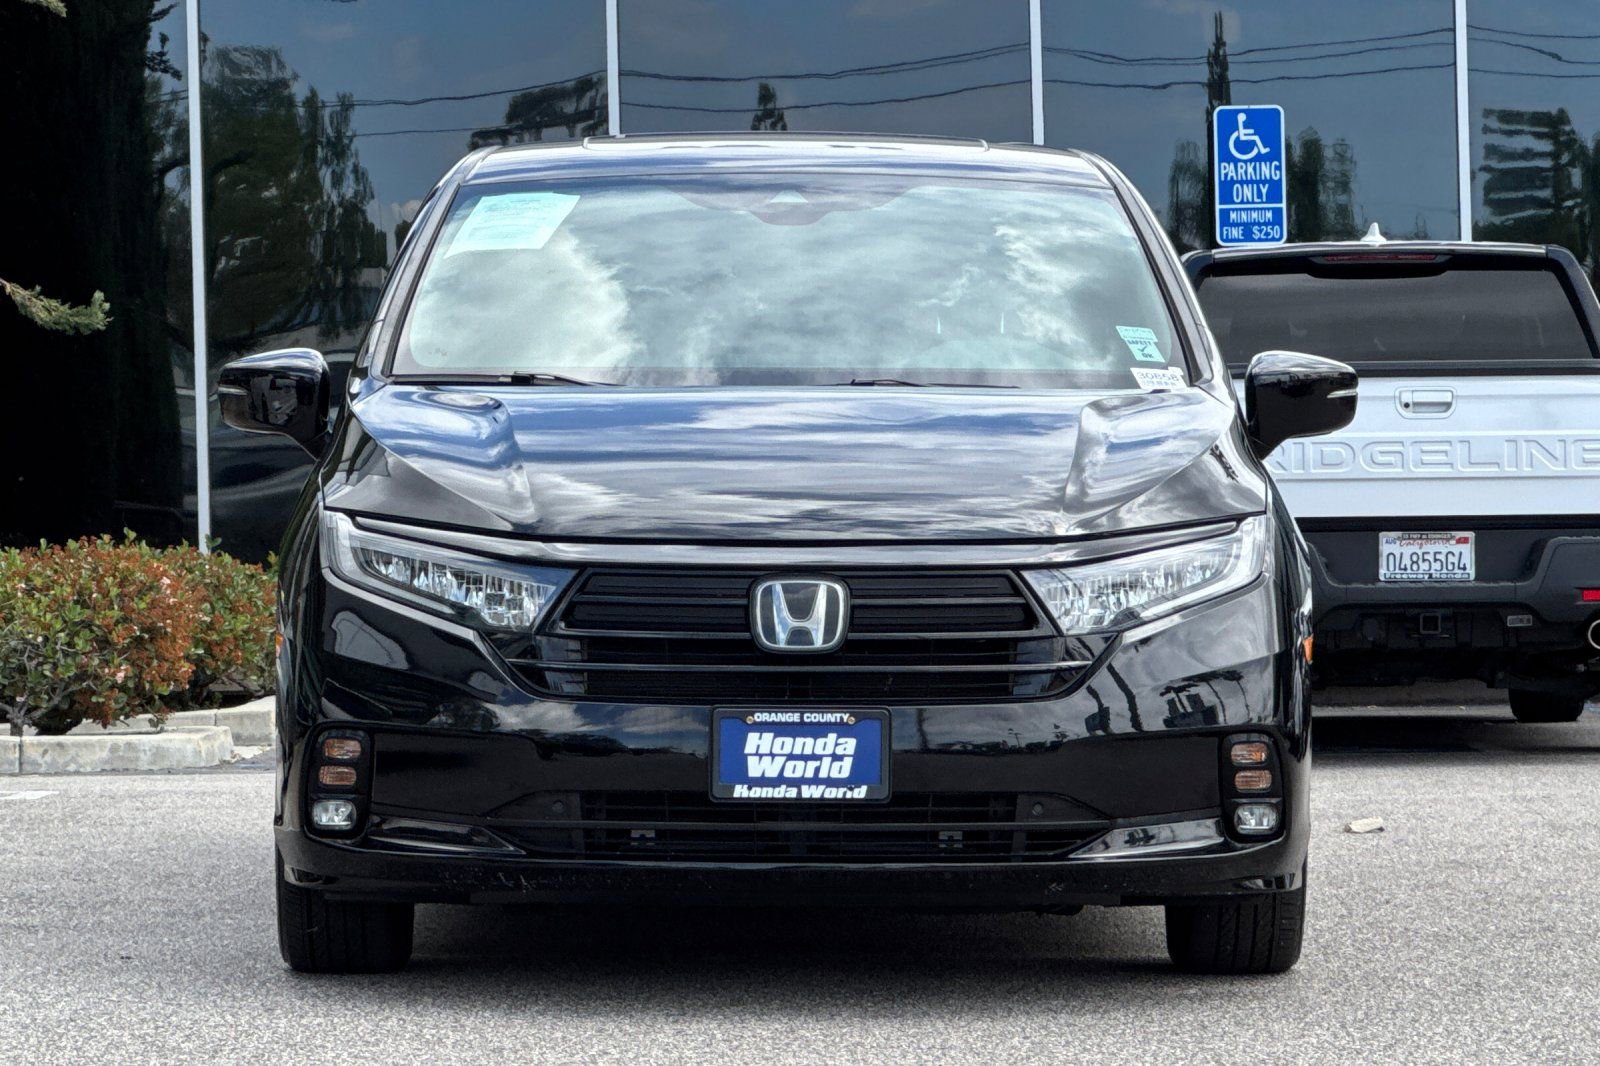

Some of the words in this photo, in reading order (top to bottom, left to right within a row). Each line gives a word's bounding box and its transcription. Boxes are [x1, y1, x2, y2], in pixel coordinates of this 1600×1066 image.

[1220, 161, 1280, 181] PARKING
[1233, 183, 1269, 203] ONLY
[1229, 209, 1273, 223] MINIMUM
[1223, 226, 1245, 240] FINE
[1252, 225, 1280, 240] $250
[1386, 551, 1468, 572] 04855G4
[1385, 572, 1430, 580] Freeway
[753, 712, 800, 723] ORANGE
[803, 712, 850, 723] COUNTY
[743, 732, 857, 756] Honda
[747, 756, 853, 779] World
[733, 784, 798, 799] Honda
[801, 784, 868, 799] World
